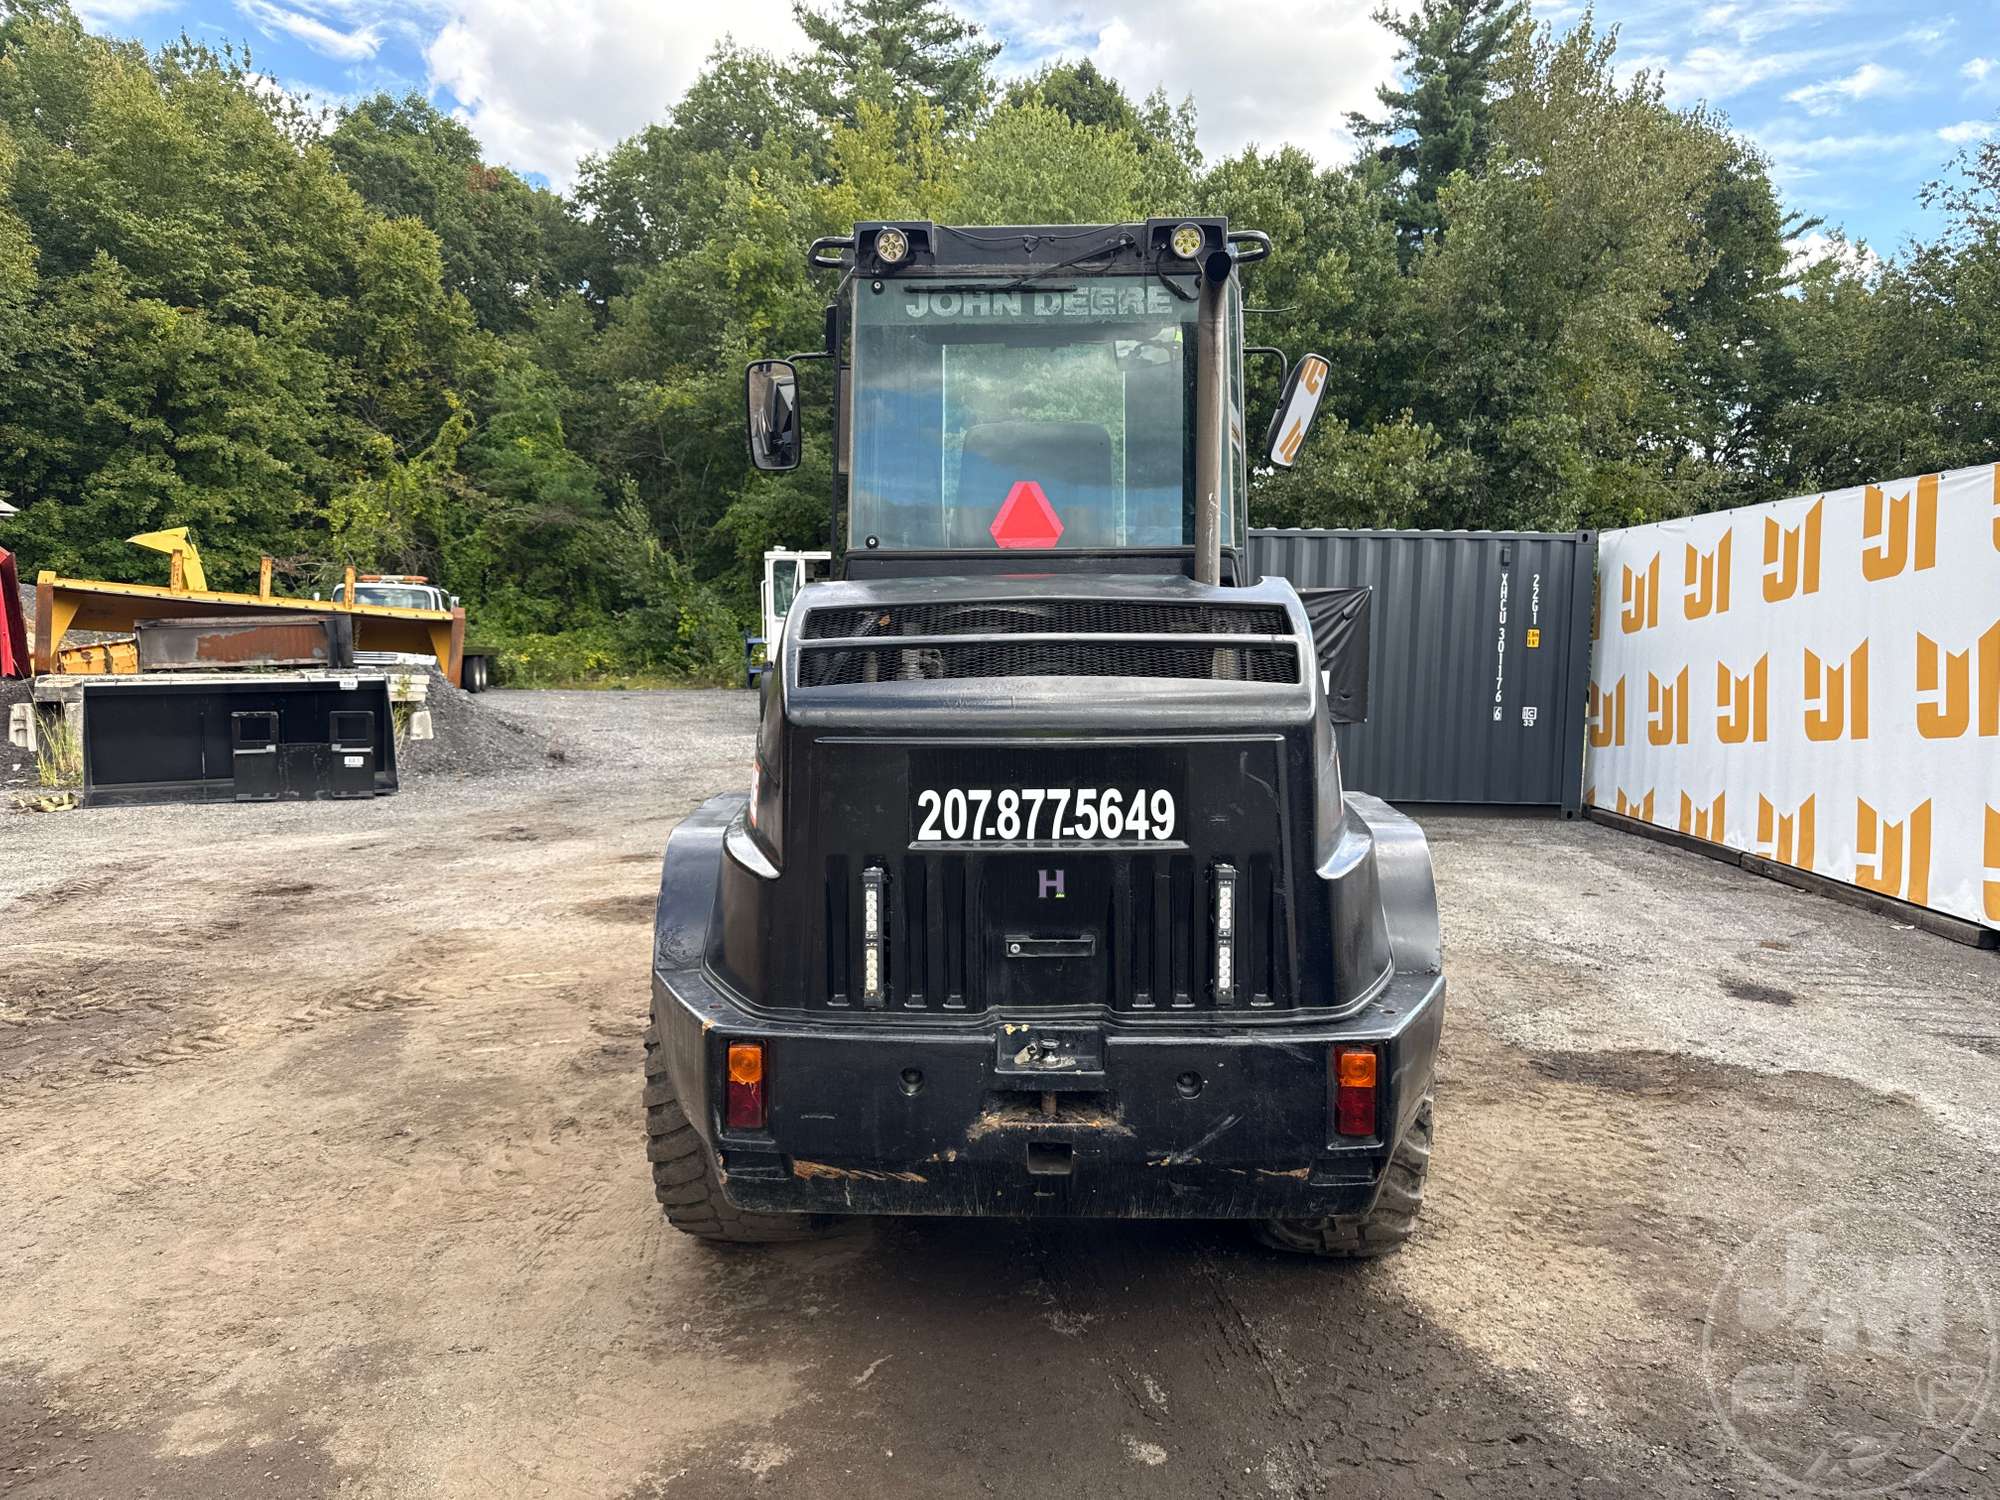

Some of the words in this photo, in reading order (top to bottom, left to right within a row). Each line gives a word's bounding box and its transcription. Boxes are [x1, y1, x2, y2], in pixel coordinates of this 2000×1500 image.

[905, 287, 1022, 318] JOHN
[1034, 286, 1172, 315] DEERE
[1499, 573, 1508, 624] XHCU
[1531, 574, 1540, 624] 22G1
[1495, 627, 1505, 702] 301176
[1038, 869, 1064, 898] H
